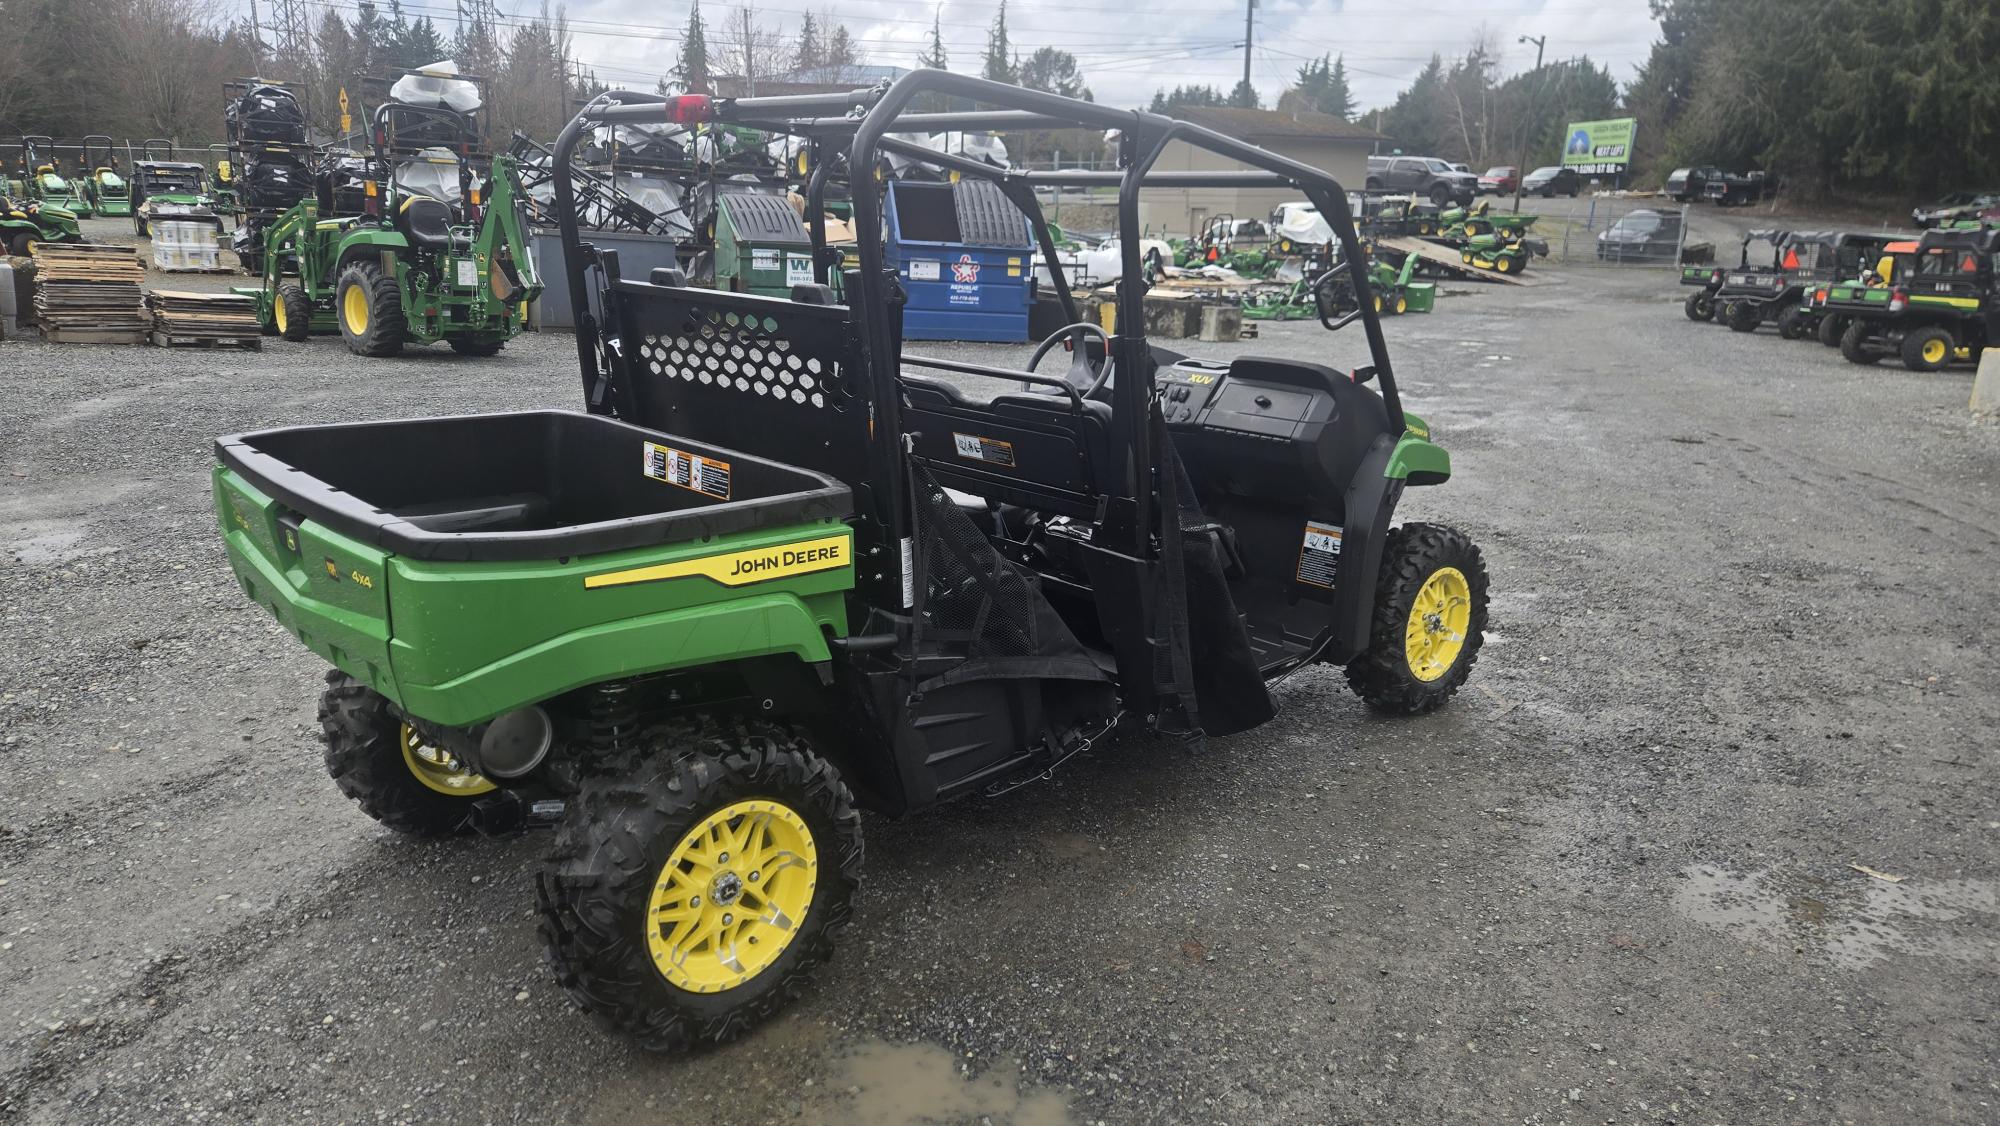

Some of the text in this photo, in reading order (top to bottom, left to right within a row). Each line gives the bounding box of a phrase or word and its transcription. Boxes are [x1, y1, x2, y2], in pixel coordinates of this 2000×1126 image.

[1595, 145, 1610, 157] NEXT
[1188, 374, 1215, 384] XUV
[731, 546, 839, 576] JOHN DEERE
